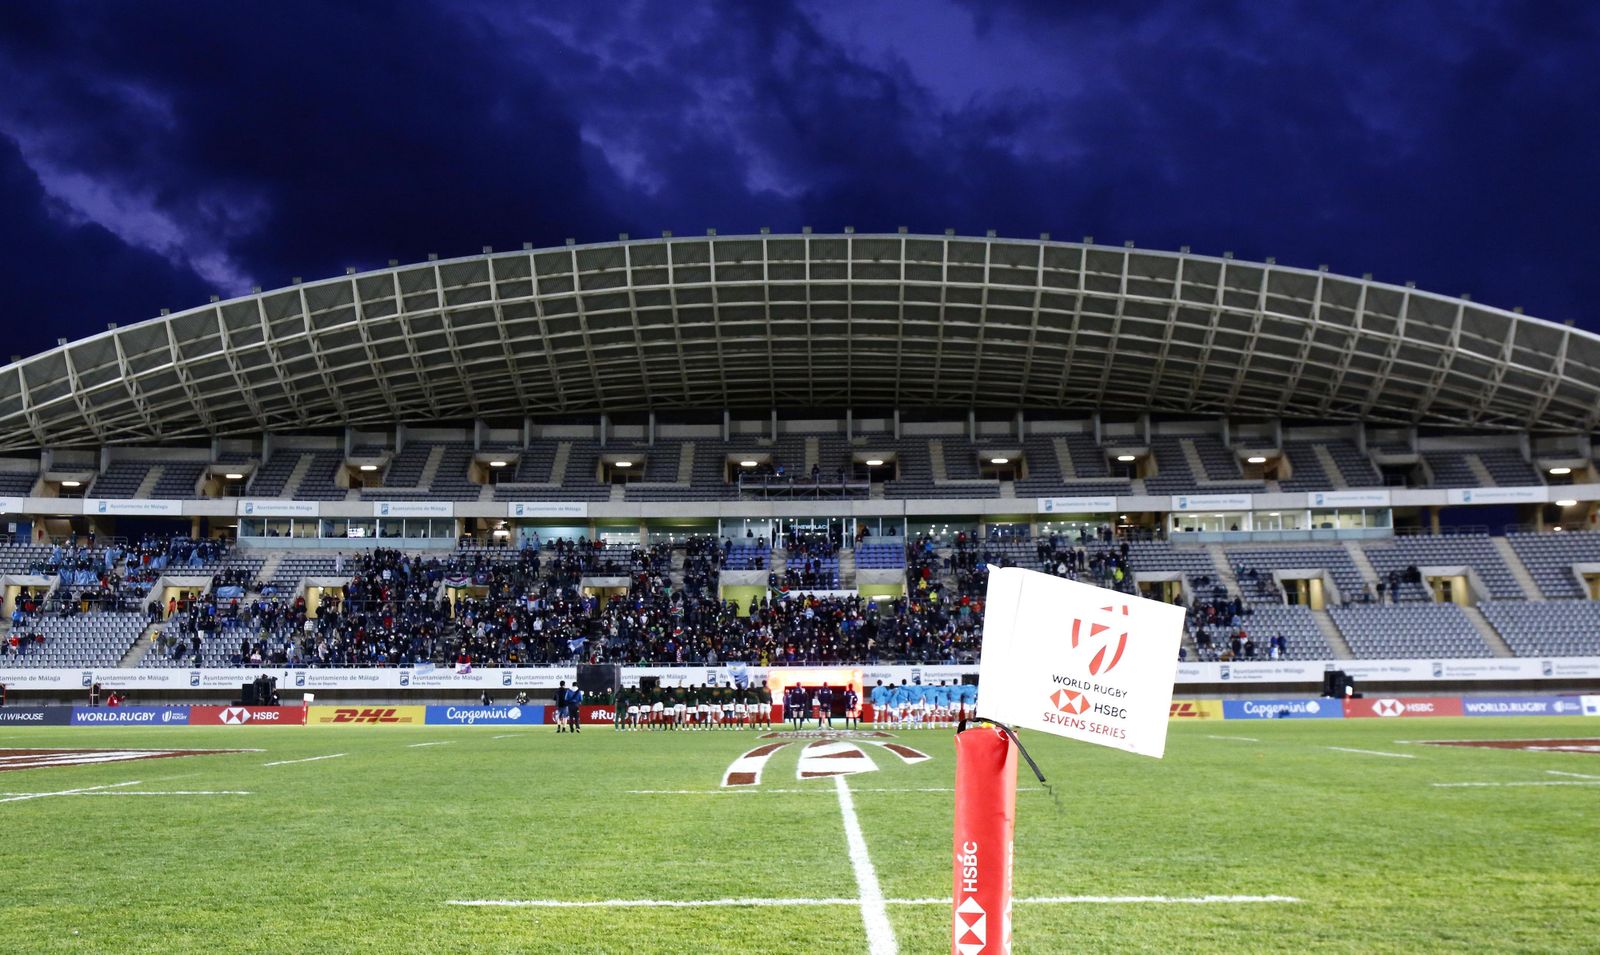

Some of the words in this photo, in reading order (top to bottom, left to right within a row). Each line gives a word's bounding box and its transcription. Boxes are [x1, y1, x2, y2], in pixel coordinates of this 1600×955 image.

[1052, 674, 1091, 691] WORLD
[1093, 684, 1128, 698] RUGBY
[1094, 702, 1128, 719] HSBC
[1244, 702, 1306, 718] Capgemini
[1406, 703, 1434, 712] HSBC
[1465, 702, 1547, 712] WORLD.RUGBY
[77, 712, 156, 722] WORLD.RUGBY
[253, 712, 280, 720] HSBC
[332, 709, 400, 723] DHL
[447, 707, 507, 724] Capgemini
[1042, 712, 1086, 730] SEVENS
[1089, 723, 1127, 739] SERIES
[963, 841, 978, 892] HSBC
